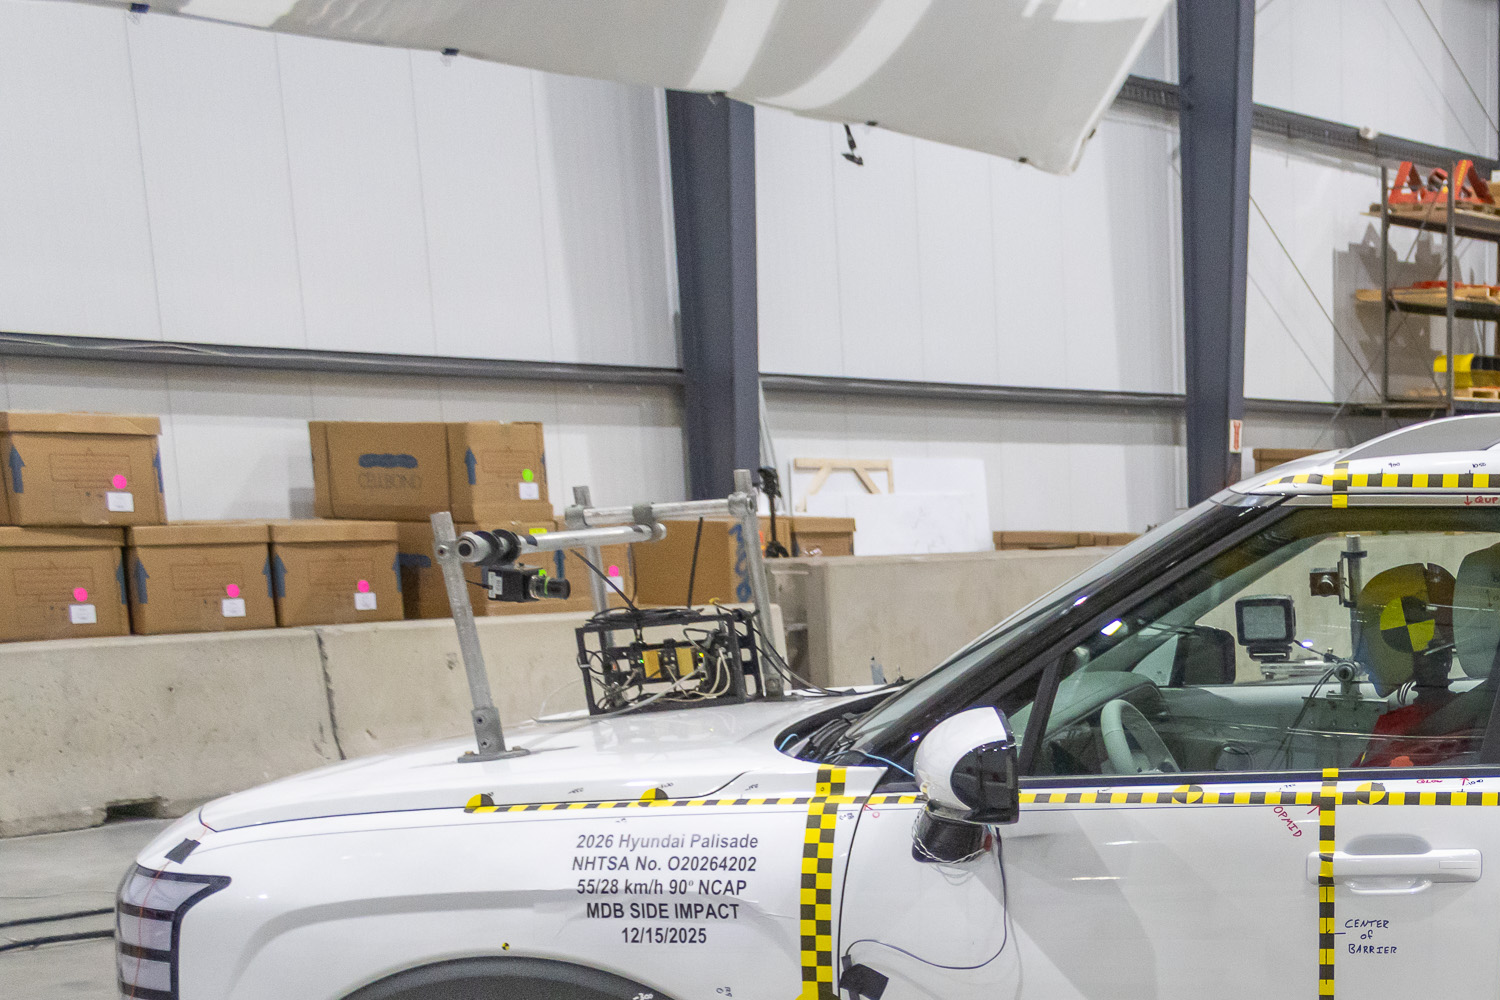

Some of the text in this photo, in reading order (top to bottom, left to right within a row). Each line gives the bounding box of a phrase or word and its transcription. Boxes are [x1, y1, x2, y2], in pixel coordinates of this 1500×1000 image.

[576, 834, 759, 852] 2026 Hyundai Palisade
[571, 856, 630, 871] NHTSA
[635, 856, 662, 871] No.
[576, 878, 619, 895] 55/28
[624, 879, 664, 895] km/h
[698, 879, 747, 896] NCAP
[586, 902, 740, 920] MDB SIDE IMPACT
[1344, 919, 1390, 929] CENTER
[621, 927, 708, 944] 12/15/2025
[1360, 929, 1373, 941] of
[1348, 944, 1398, 955] BARRIER
[632, 992, 654, 1000] -300
